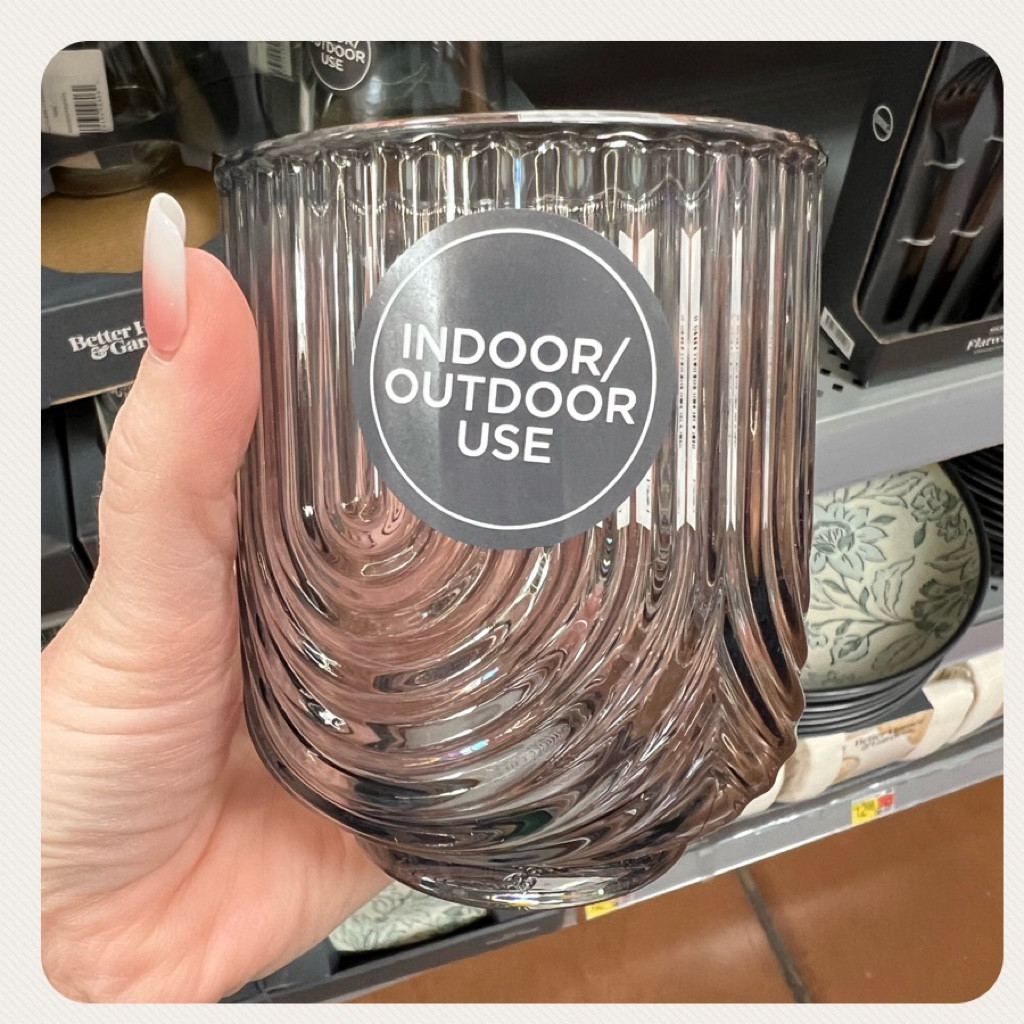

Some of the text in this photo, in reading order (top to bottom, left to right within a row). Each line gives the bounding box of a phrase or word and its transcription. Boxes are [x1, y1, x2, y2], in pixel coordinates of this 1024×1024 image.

[321, 52, 344, 71] USE
[68, 326, 131, 352] Better
[403, 323, 631, 382] INDOOR/
[385, 368, 637, 424] OUTDOOR
[457, 420, 553, 463] USE
